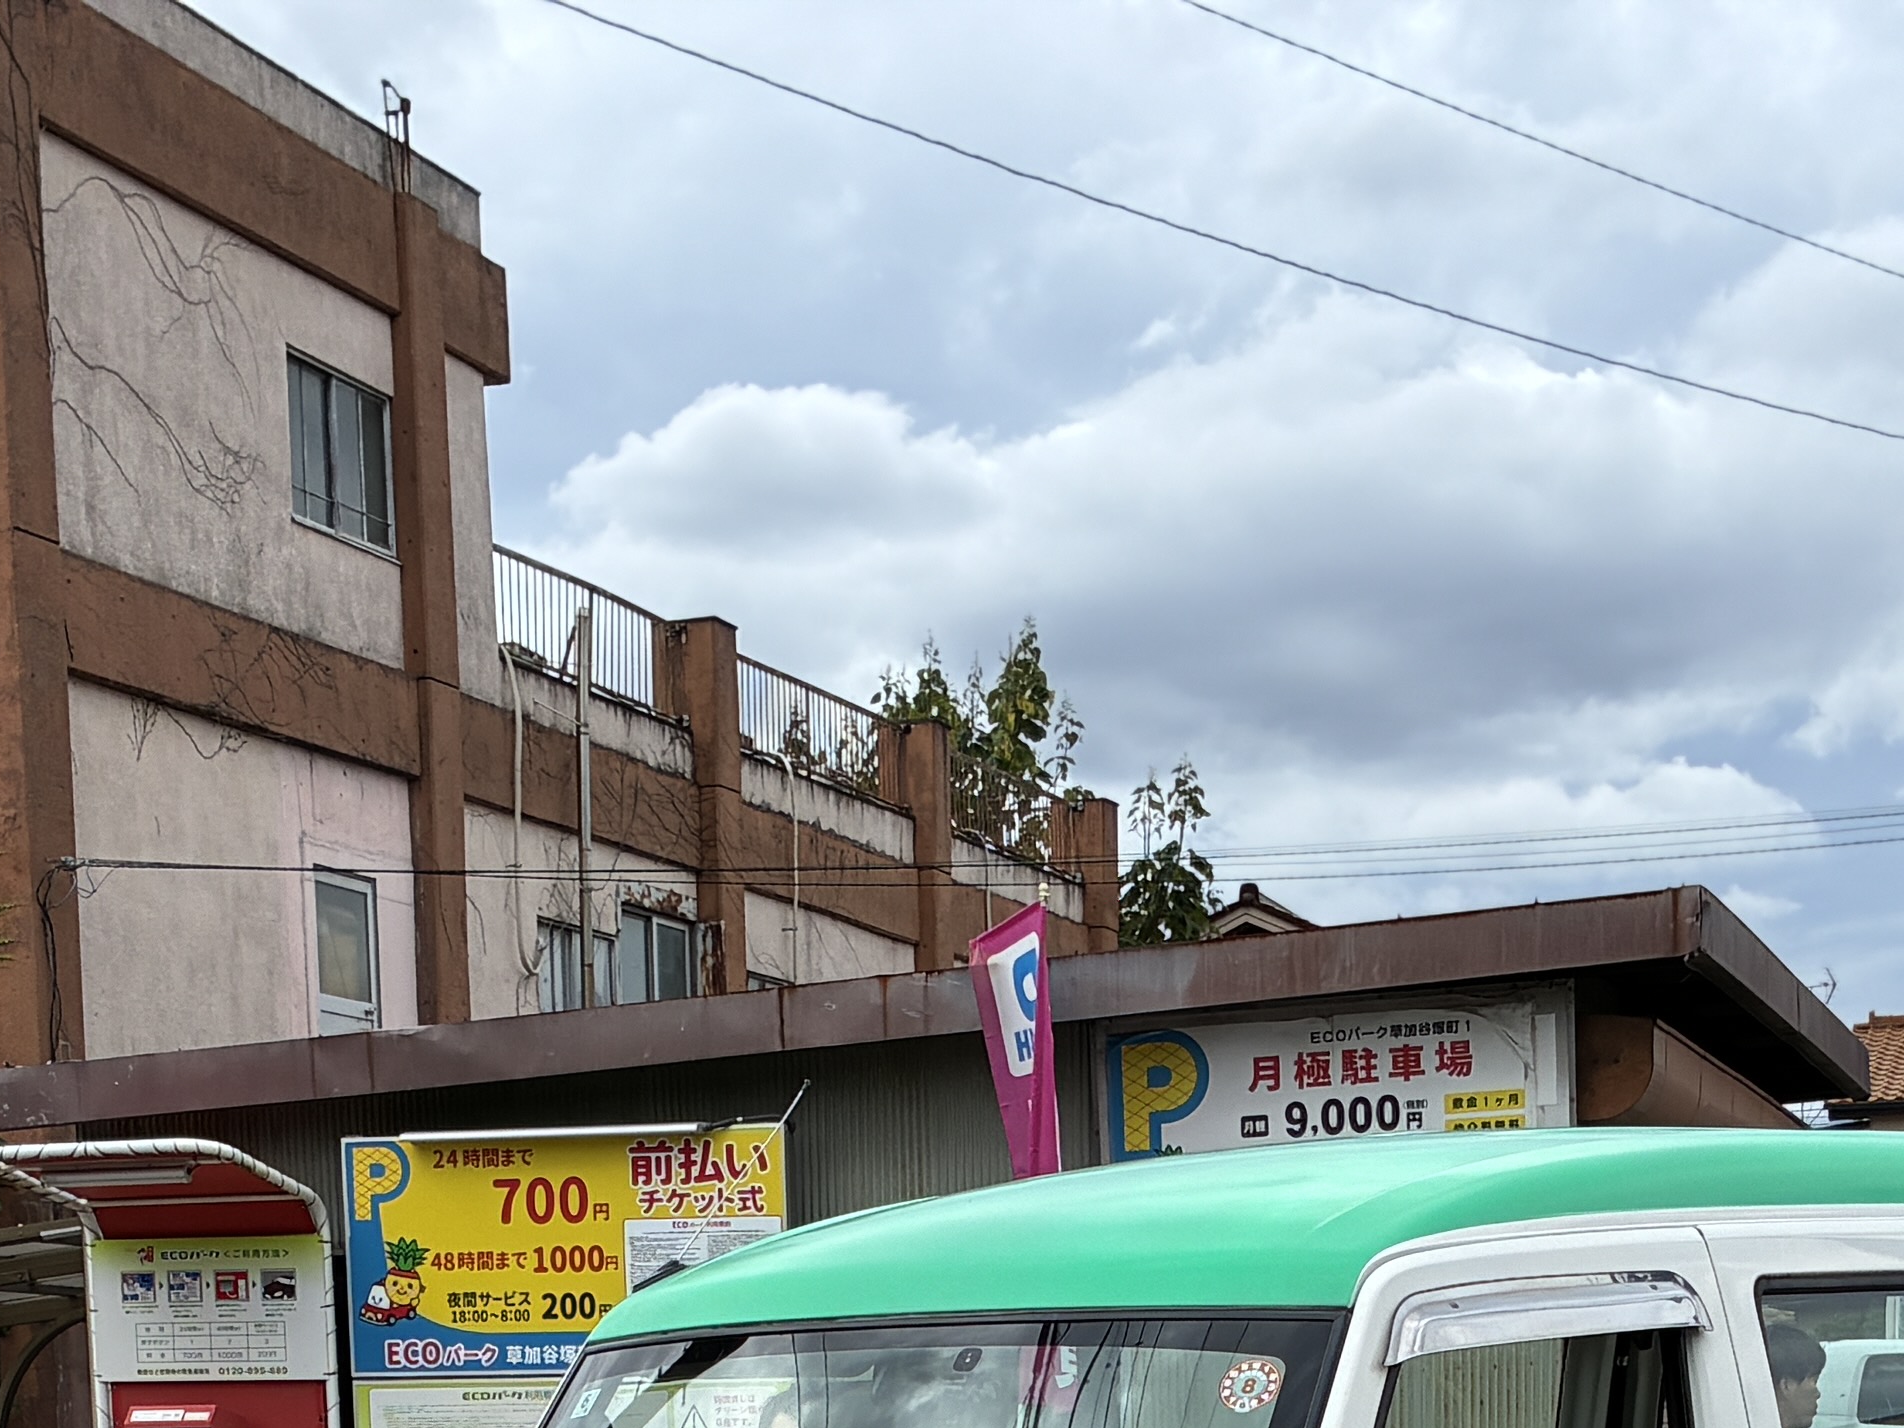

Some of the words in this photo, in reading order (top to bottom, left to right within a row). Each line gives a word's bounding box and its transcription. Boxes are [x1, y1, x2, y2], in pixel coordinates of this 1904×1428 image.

[1248, 1039, 1475, 1095] 月極駐車場
[432, 1147, 535, 1171] 24時間まで
[627, 1137, 770, 1190] 前払い
[492, 1175, 611, 1227] 700円
[637, 1185, 765, 1216] チケット式
[430, 1250, 529, 1273] 48時間まで
[532, 1244, 619, 1274] 1000円
[446, 1291, 532, 1309] 夜間サービス
[384, 1339, 499, 1369] ECOパーク
